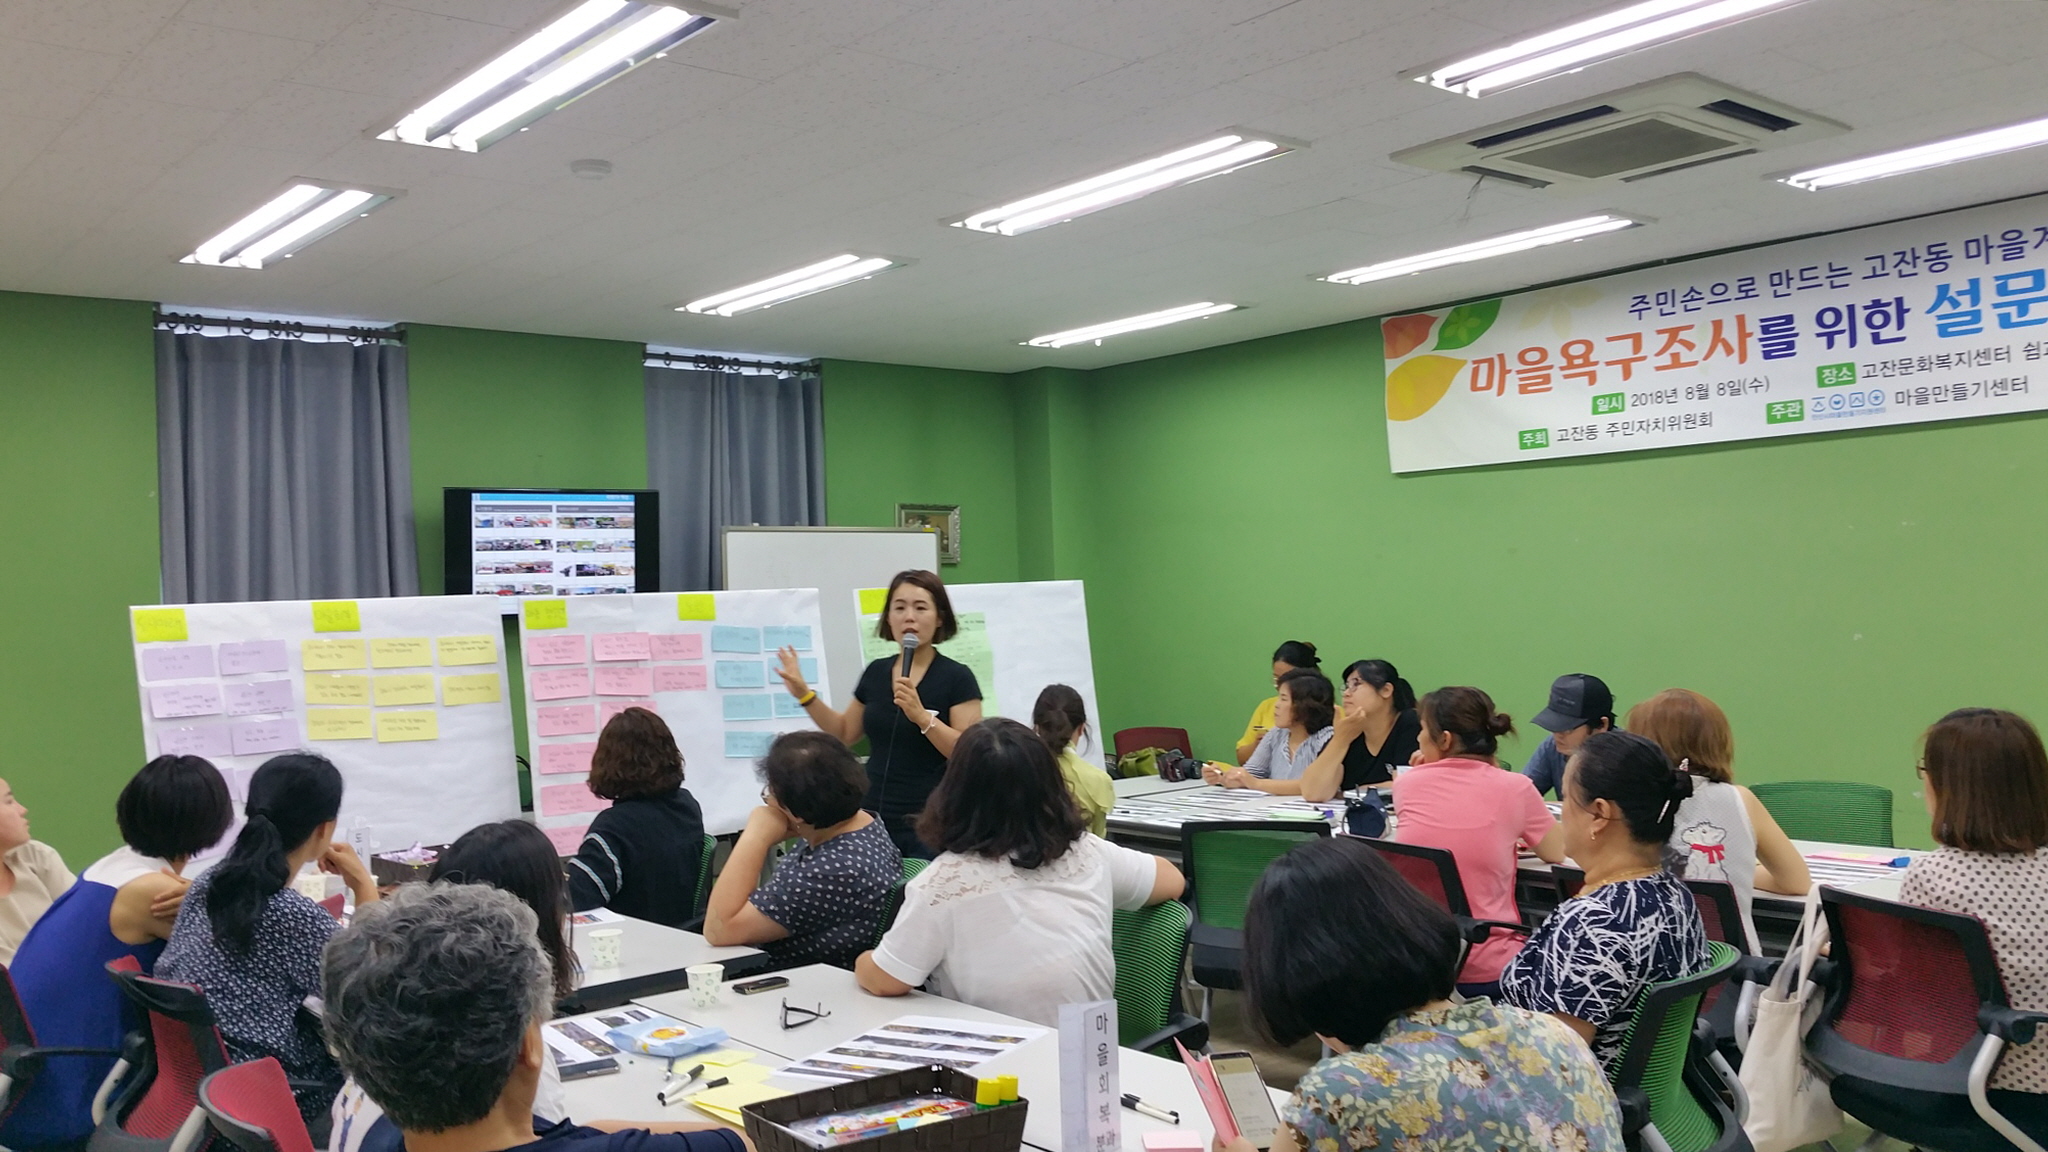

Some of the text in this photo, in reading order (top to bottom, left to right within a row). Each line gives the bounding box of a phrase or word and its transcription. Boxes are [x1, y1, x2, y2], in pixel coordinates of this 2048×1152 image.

[1629, 277, 1760, 320] 주민손으로
[1769, 262, 1852, 298] 만드는
[1862, 242, 1953, 280] 고잔동
[1470, 268, 2048, 397] 마을욕구조사를 위한 설문
[1821, 367, 1854, 385] 장소
[1861, 345, 2012, 379] 고잔문화복지센터
[1596, 375, 1770, 412] 일시 2018년 8월 8일(수)
[1771, 375, 2030, 419] 주관 마을만들기센터
[1522, 411, 1713, 447] 주최 고잔동 주민자치위원회
